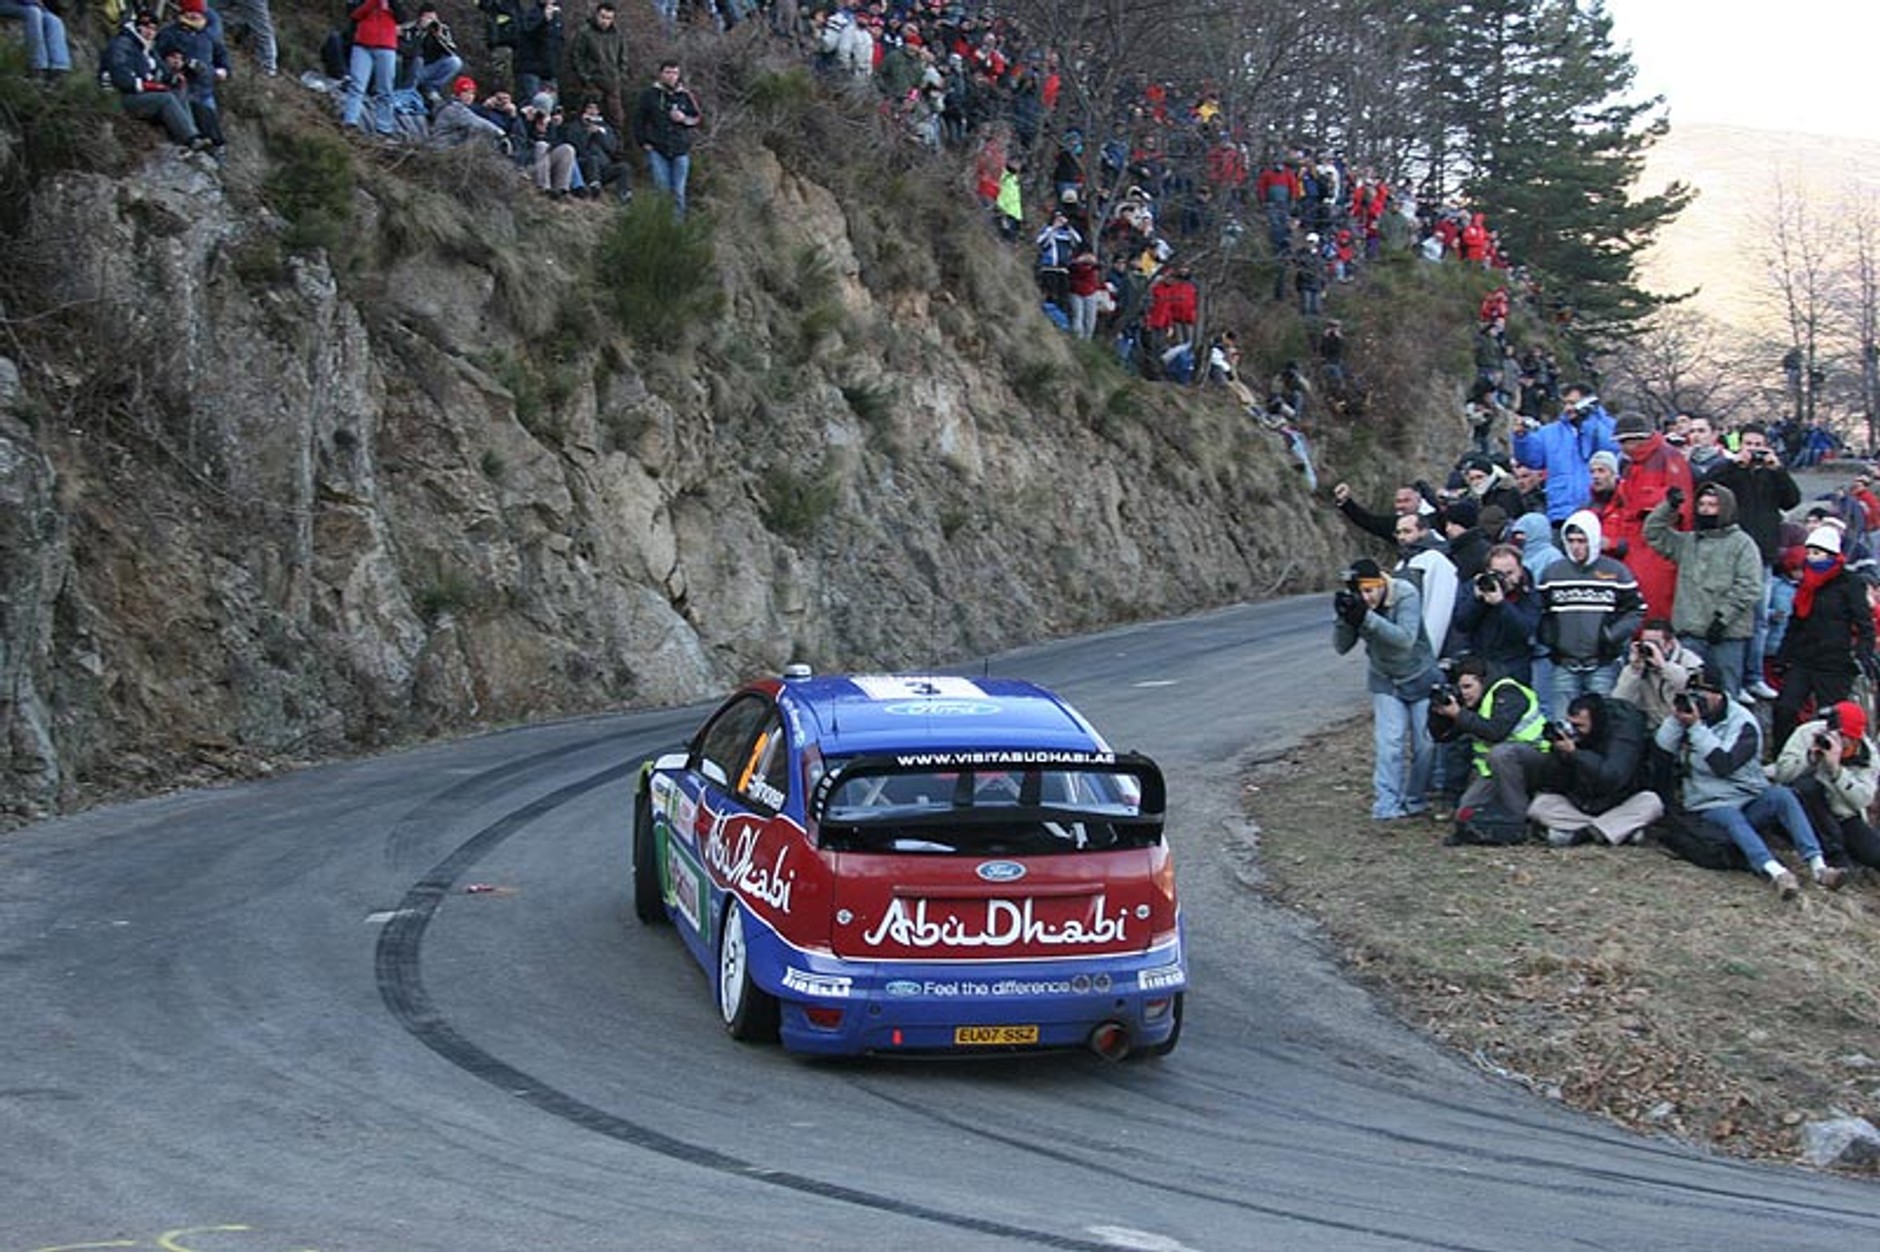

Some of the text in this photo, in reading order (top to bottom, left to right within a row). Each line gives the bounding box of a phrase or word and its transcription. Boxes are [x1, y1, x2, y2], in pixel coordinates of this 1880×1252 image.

[905, 681, 942, 695] 3
[923, 980, 1071, 996] Feel the difference
[958, 1027, 1036, 1042] EU07 SSZ
